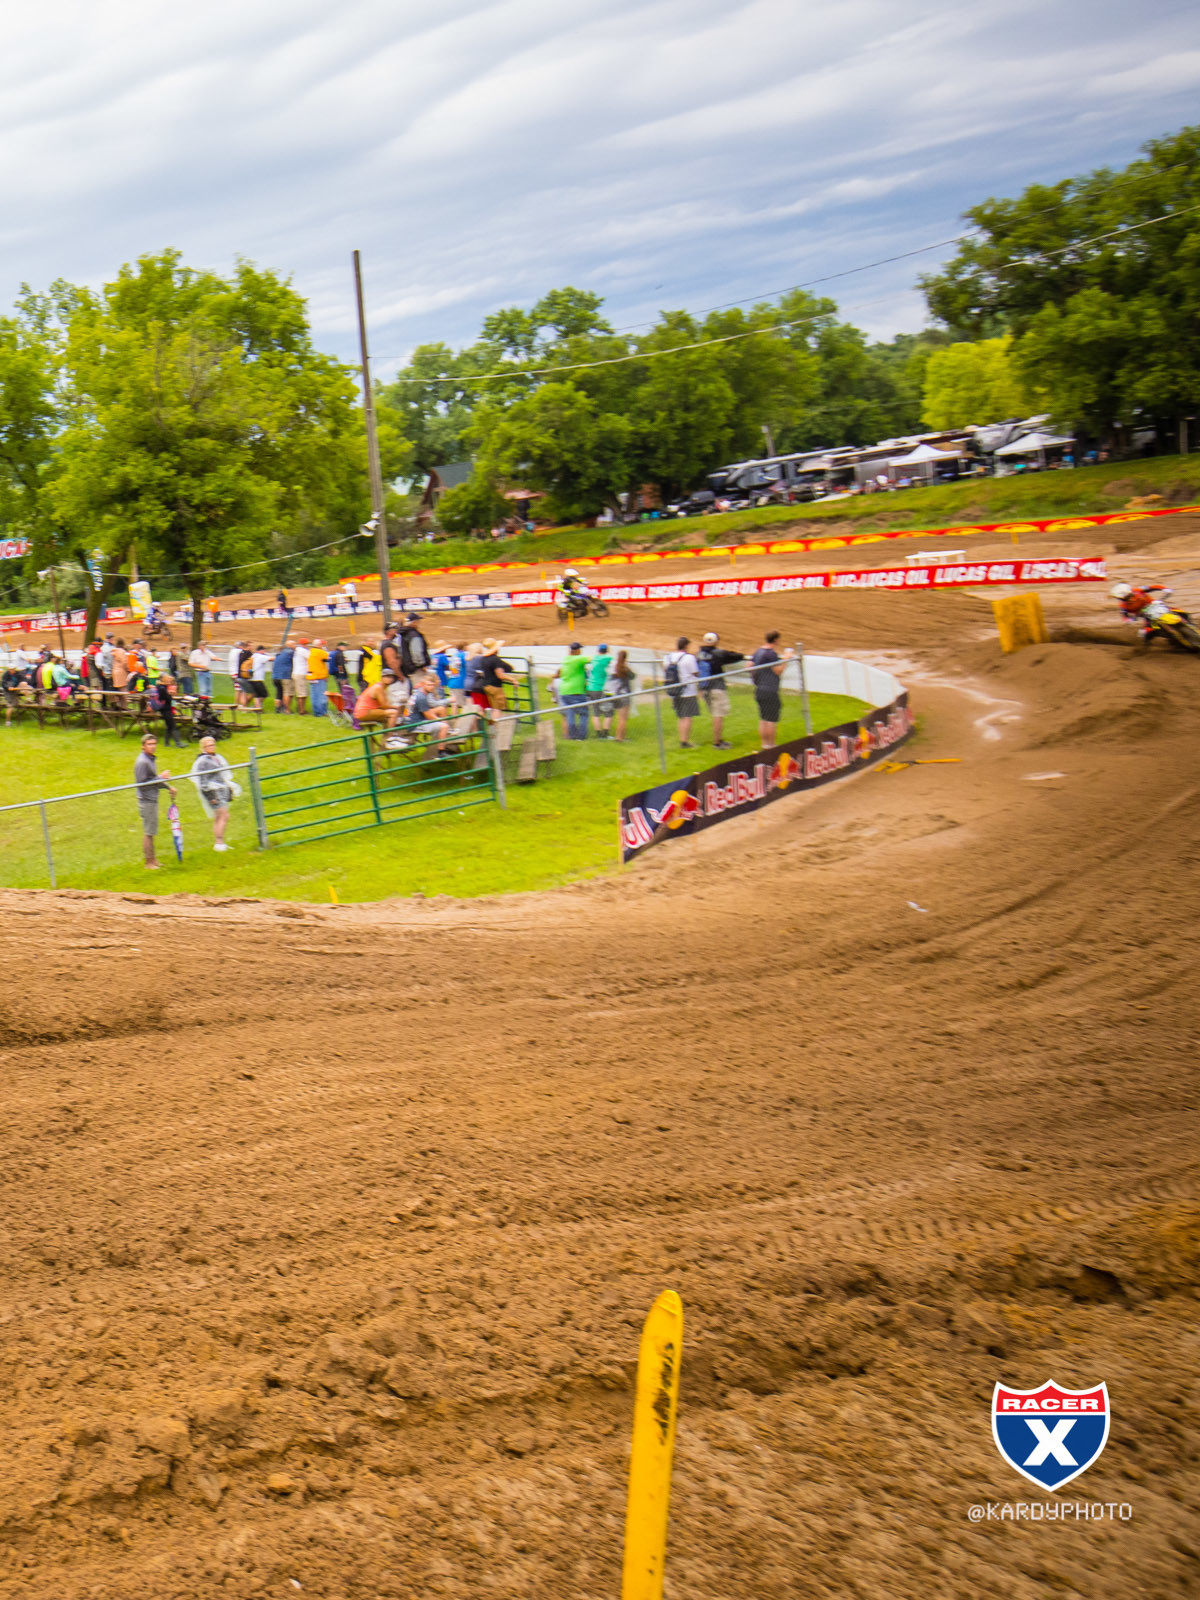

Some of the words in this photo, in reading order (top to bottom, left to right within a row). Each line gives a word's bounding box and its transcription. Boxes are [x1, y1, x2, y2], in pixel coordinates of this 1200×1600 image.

[859, 571, 905, 587] LUCAS
[905, 569, 930, 585] OIL
[934, 566, 987, 582] LUCAS
[987, 565, 1016, 580] OIL
[702, 581, 739, 597] LUCAS
[762, 578, 803, 593] LUCAS
[803, 576, 825, 589] OIL
